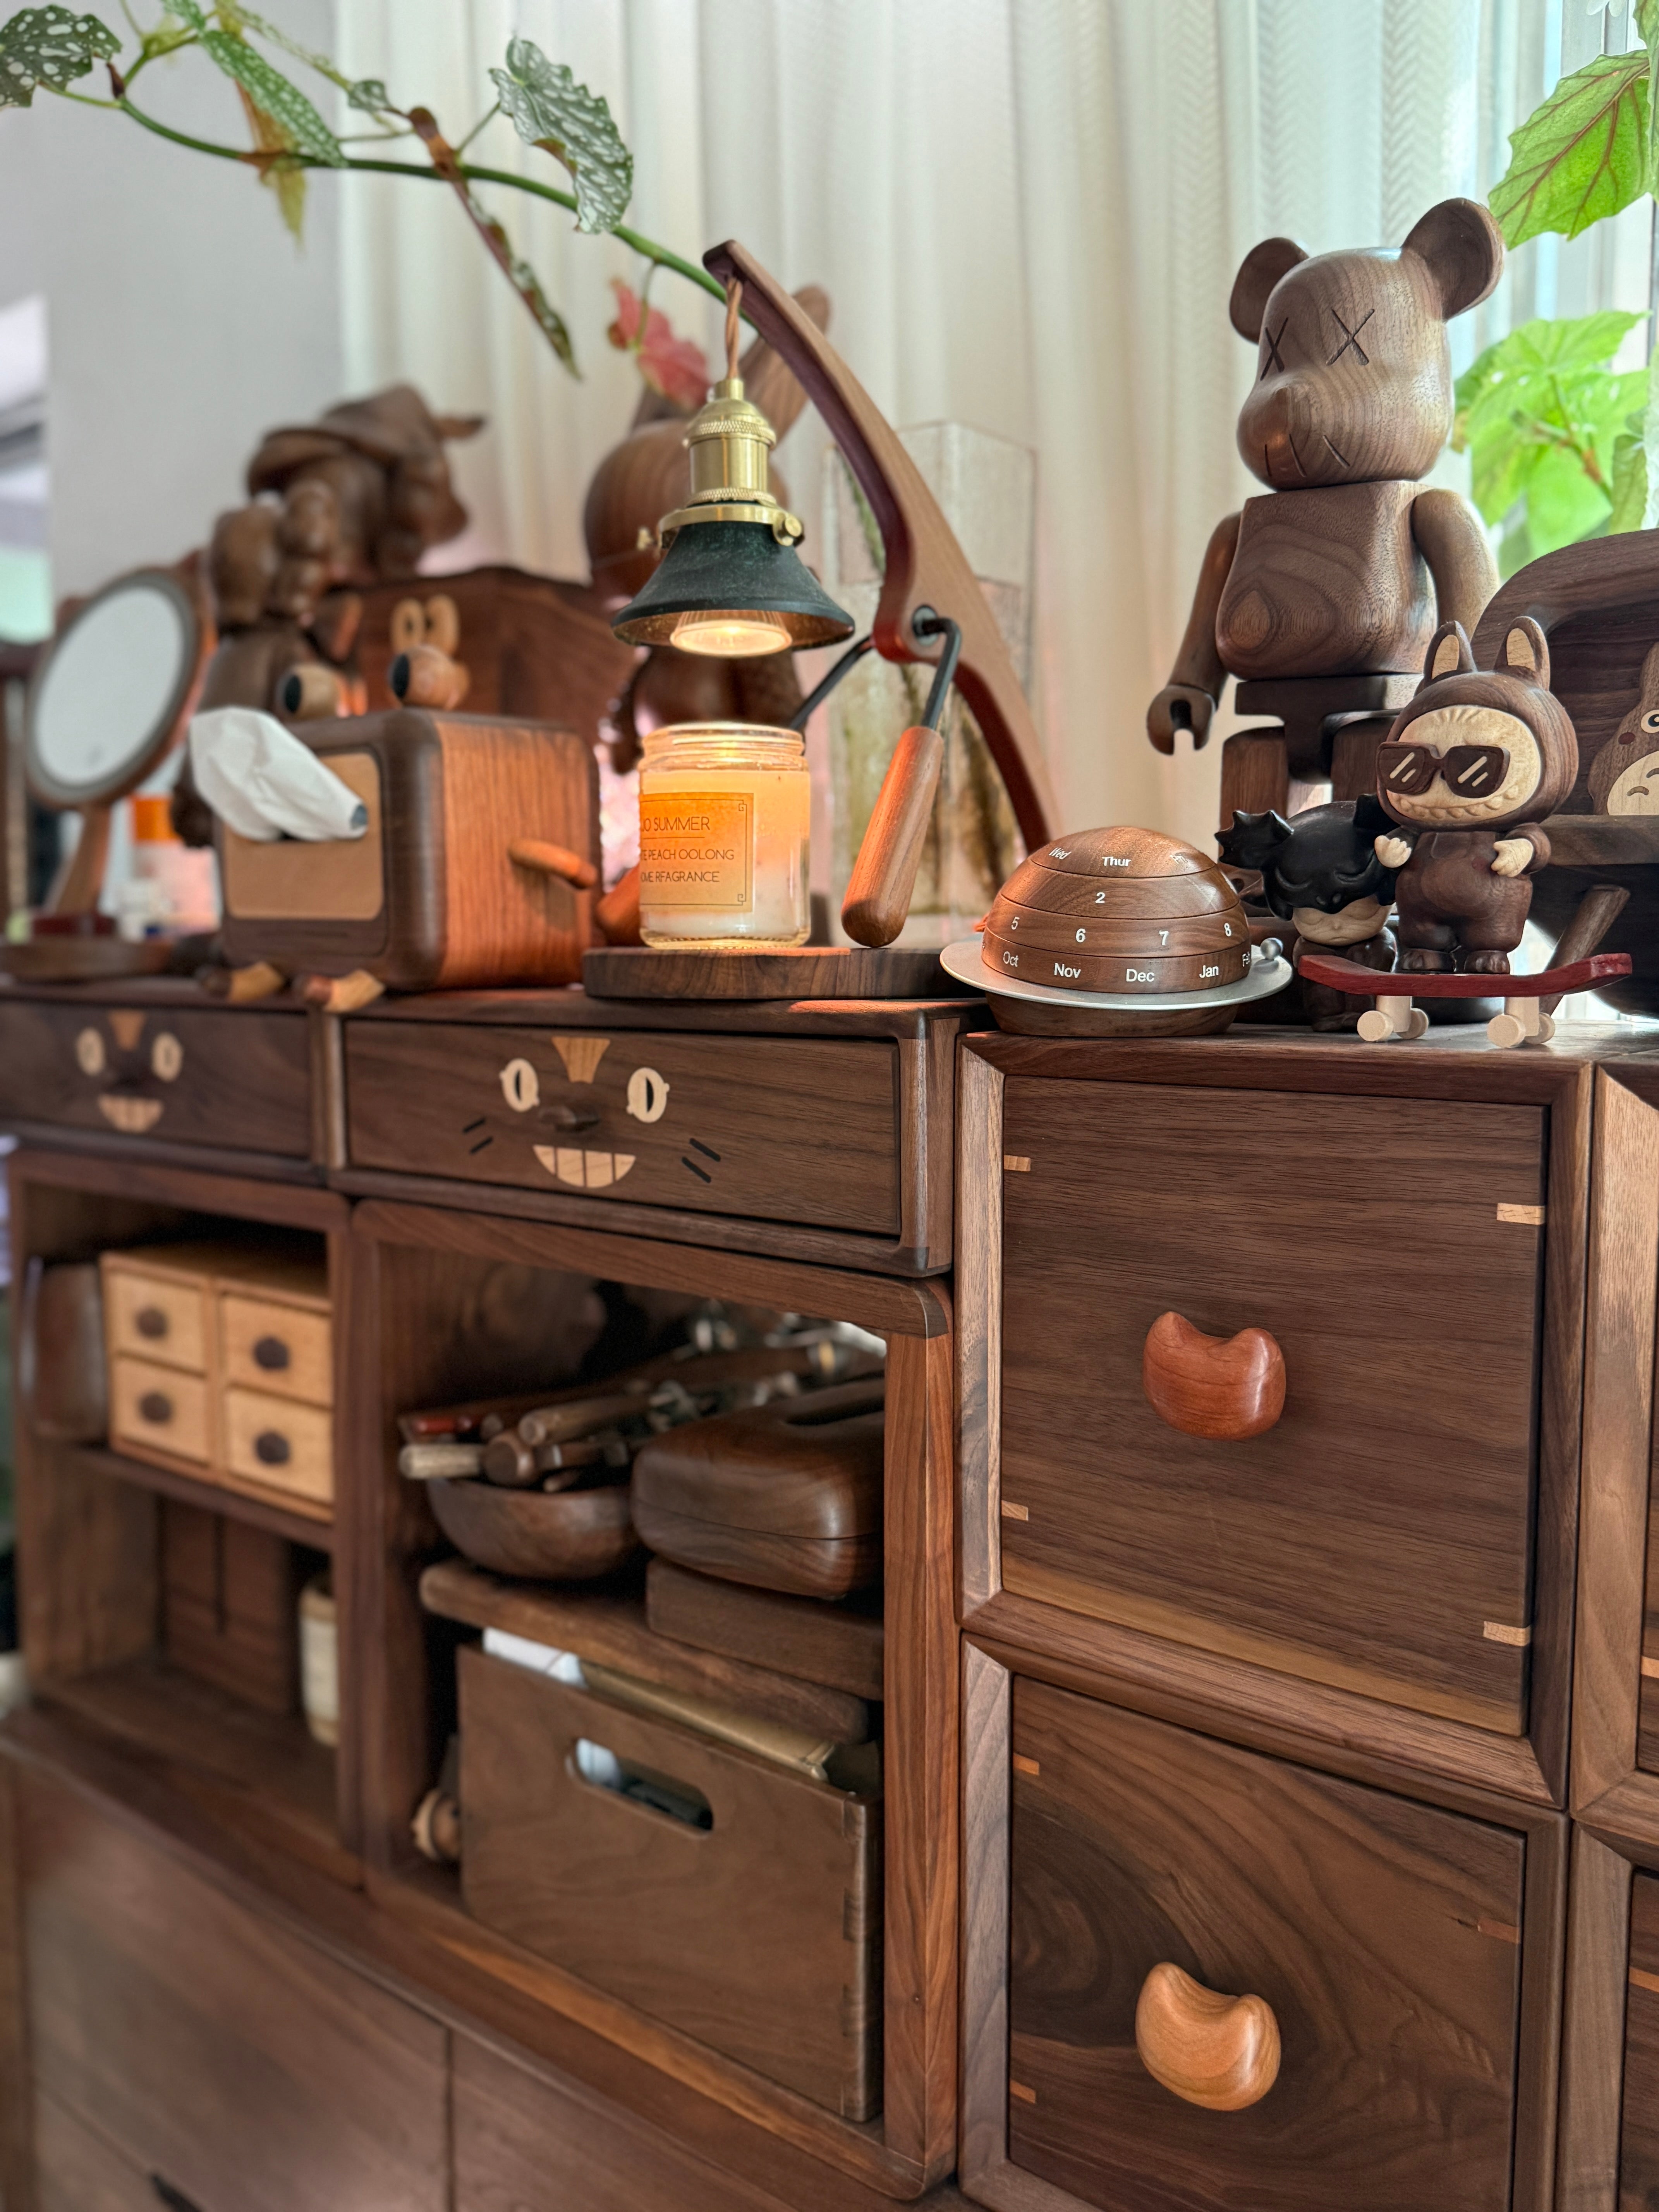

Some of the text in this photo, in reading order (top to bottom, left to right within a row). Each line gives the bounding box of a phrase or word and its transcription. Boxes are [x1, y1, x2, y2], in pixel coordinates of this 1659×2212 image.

[653, 816, 710, 831] SUMMER
[648, 848, 676, 860] PEACH
[678, 848, 734, 860] OOLONG
[1048, 847, 1072, 860] Wed
[1101, 856, 1132, 867] Thur
[655, 871, 720, 883] RFAGRANCE
[1095, 892, 1106, 903] 2
[1011, 916, 1232, 946] 5 6 7 8
[1003, 951, 1019, 967] Oct
[1054, 962, 1081, 978] Nov
[1126, 969, 1155, 982] Dec
[1199, 965, 1219, 978] Jan
